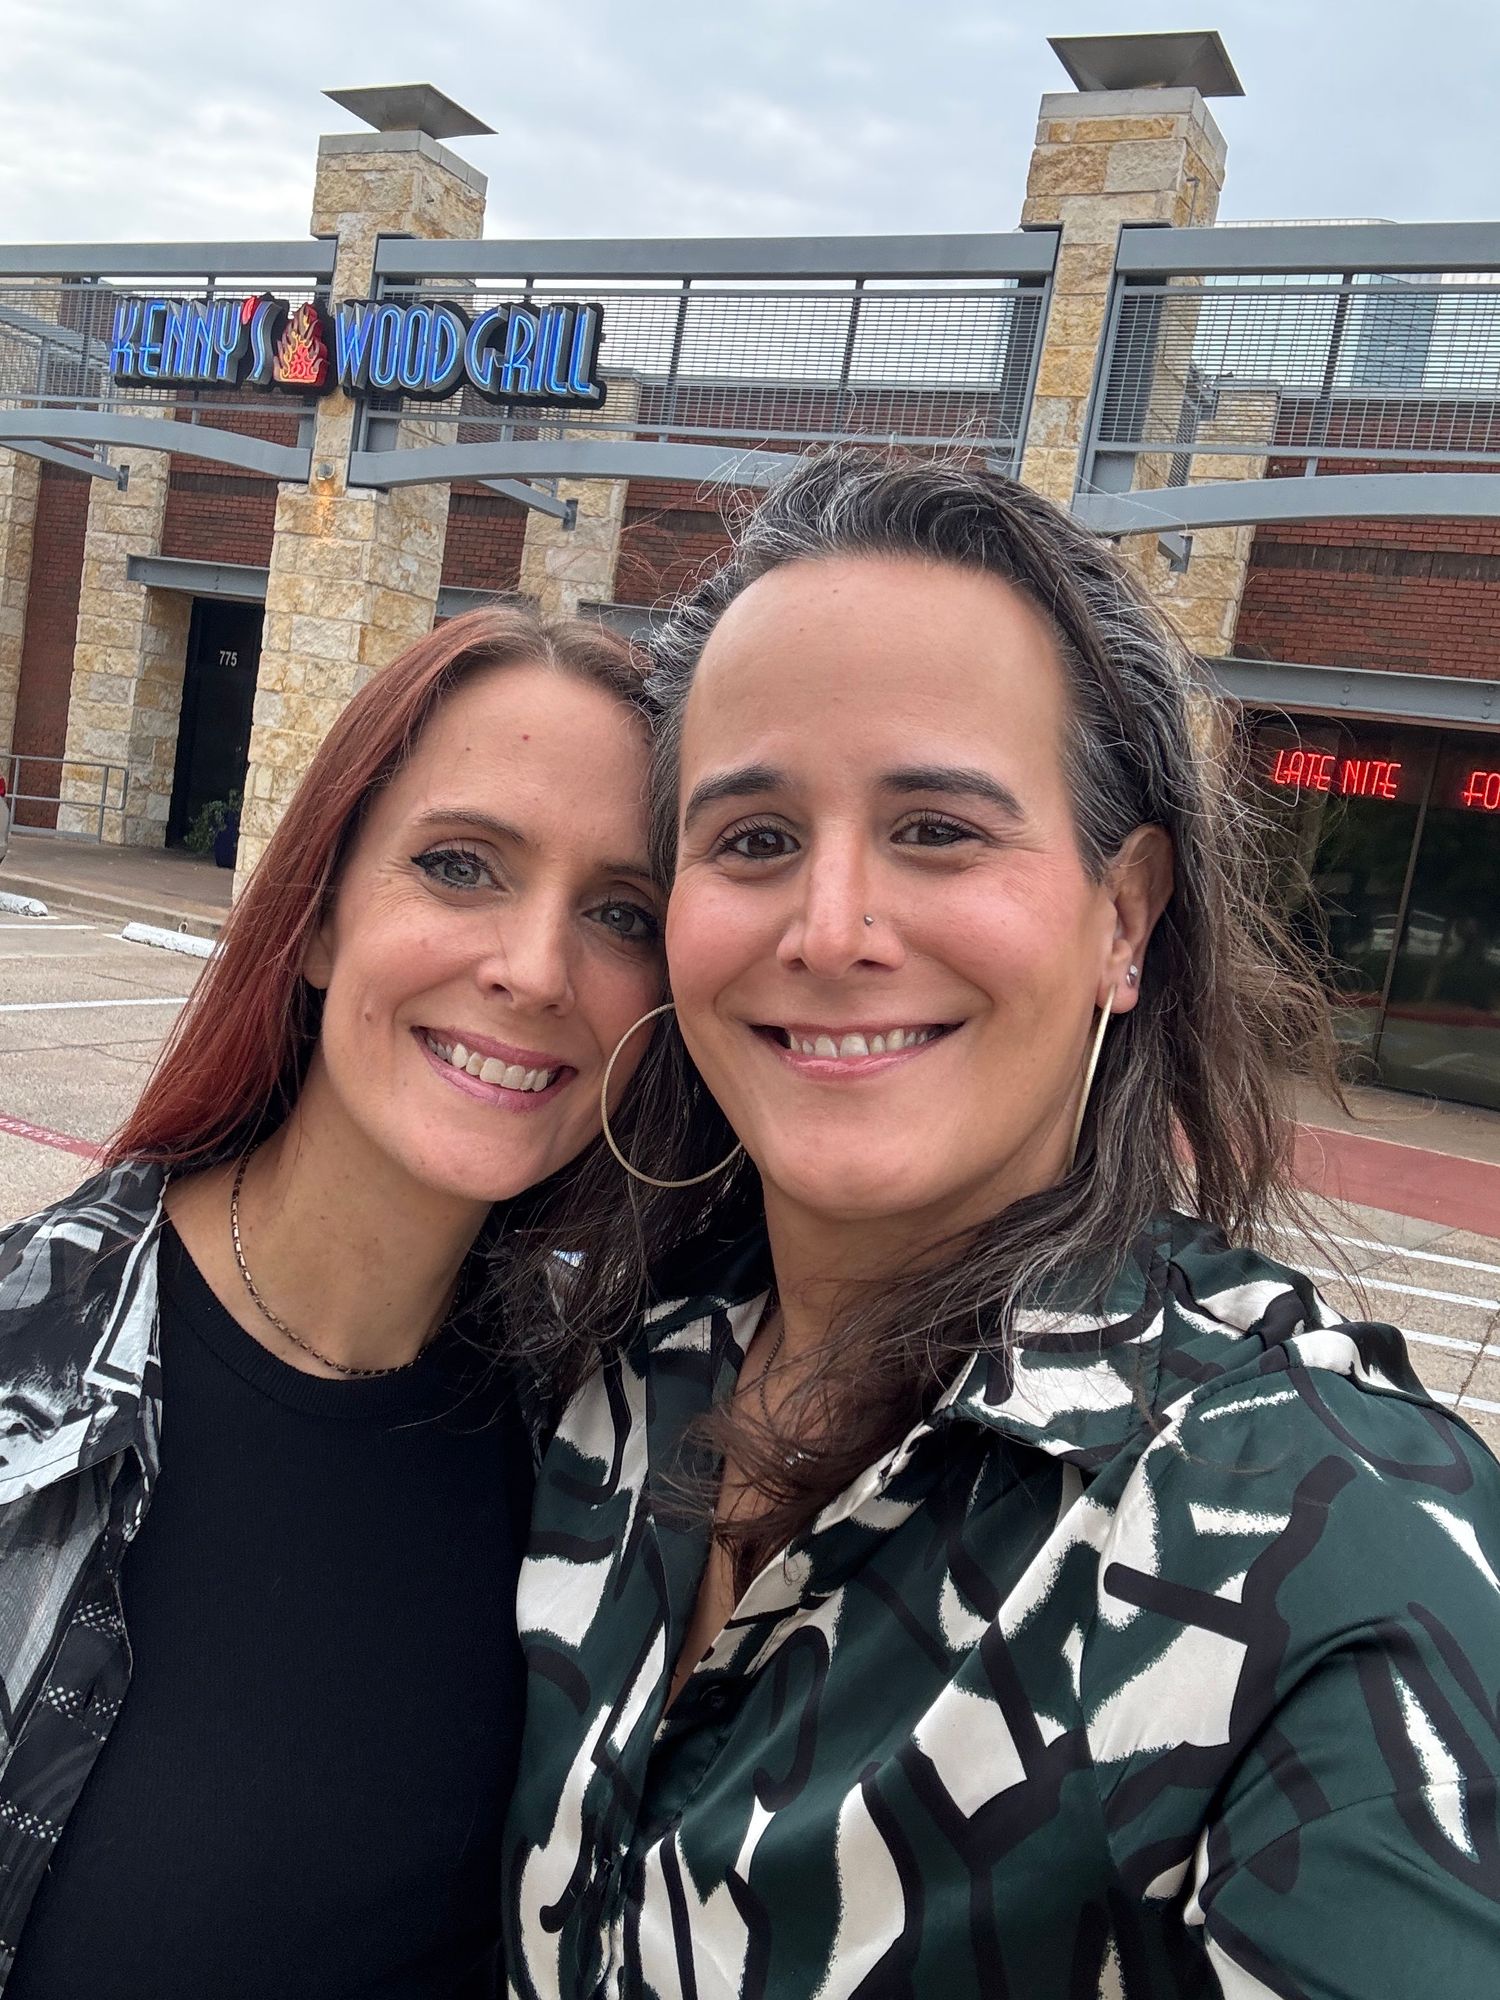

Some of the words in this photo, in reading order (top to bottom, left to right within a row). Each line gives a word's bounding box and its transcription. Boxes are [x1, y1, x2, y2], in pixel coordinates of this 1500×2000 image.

[110, 296, 281, 384] KENNY'S
[335, 303, 466, 389] WOOD
[464, 305, 598, 398] GRILL
[219, 650, 238, 667] 775
[1274, 750, 1335, 791] LATE
[1342, 759, 1402, 799] NITE
